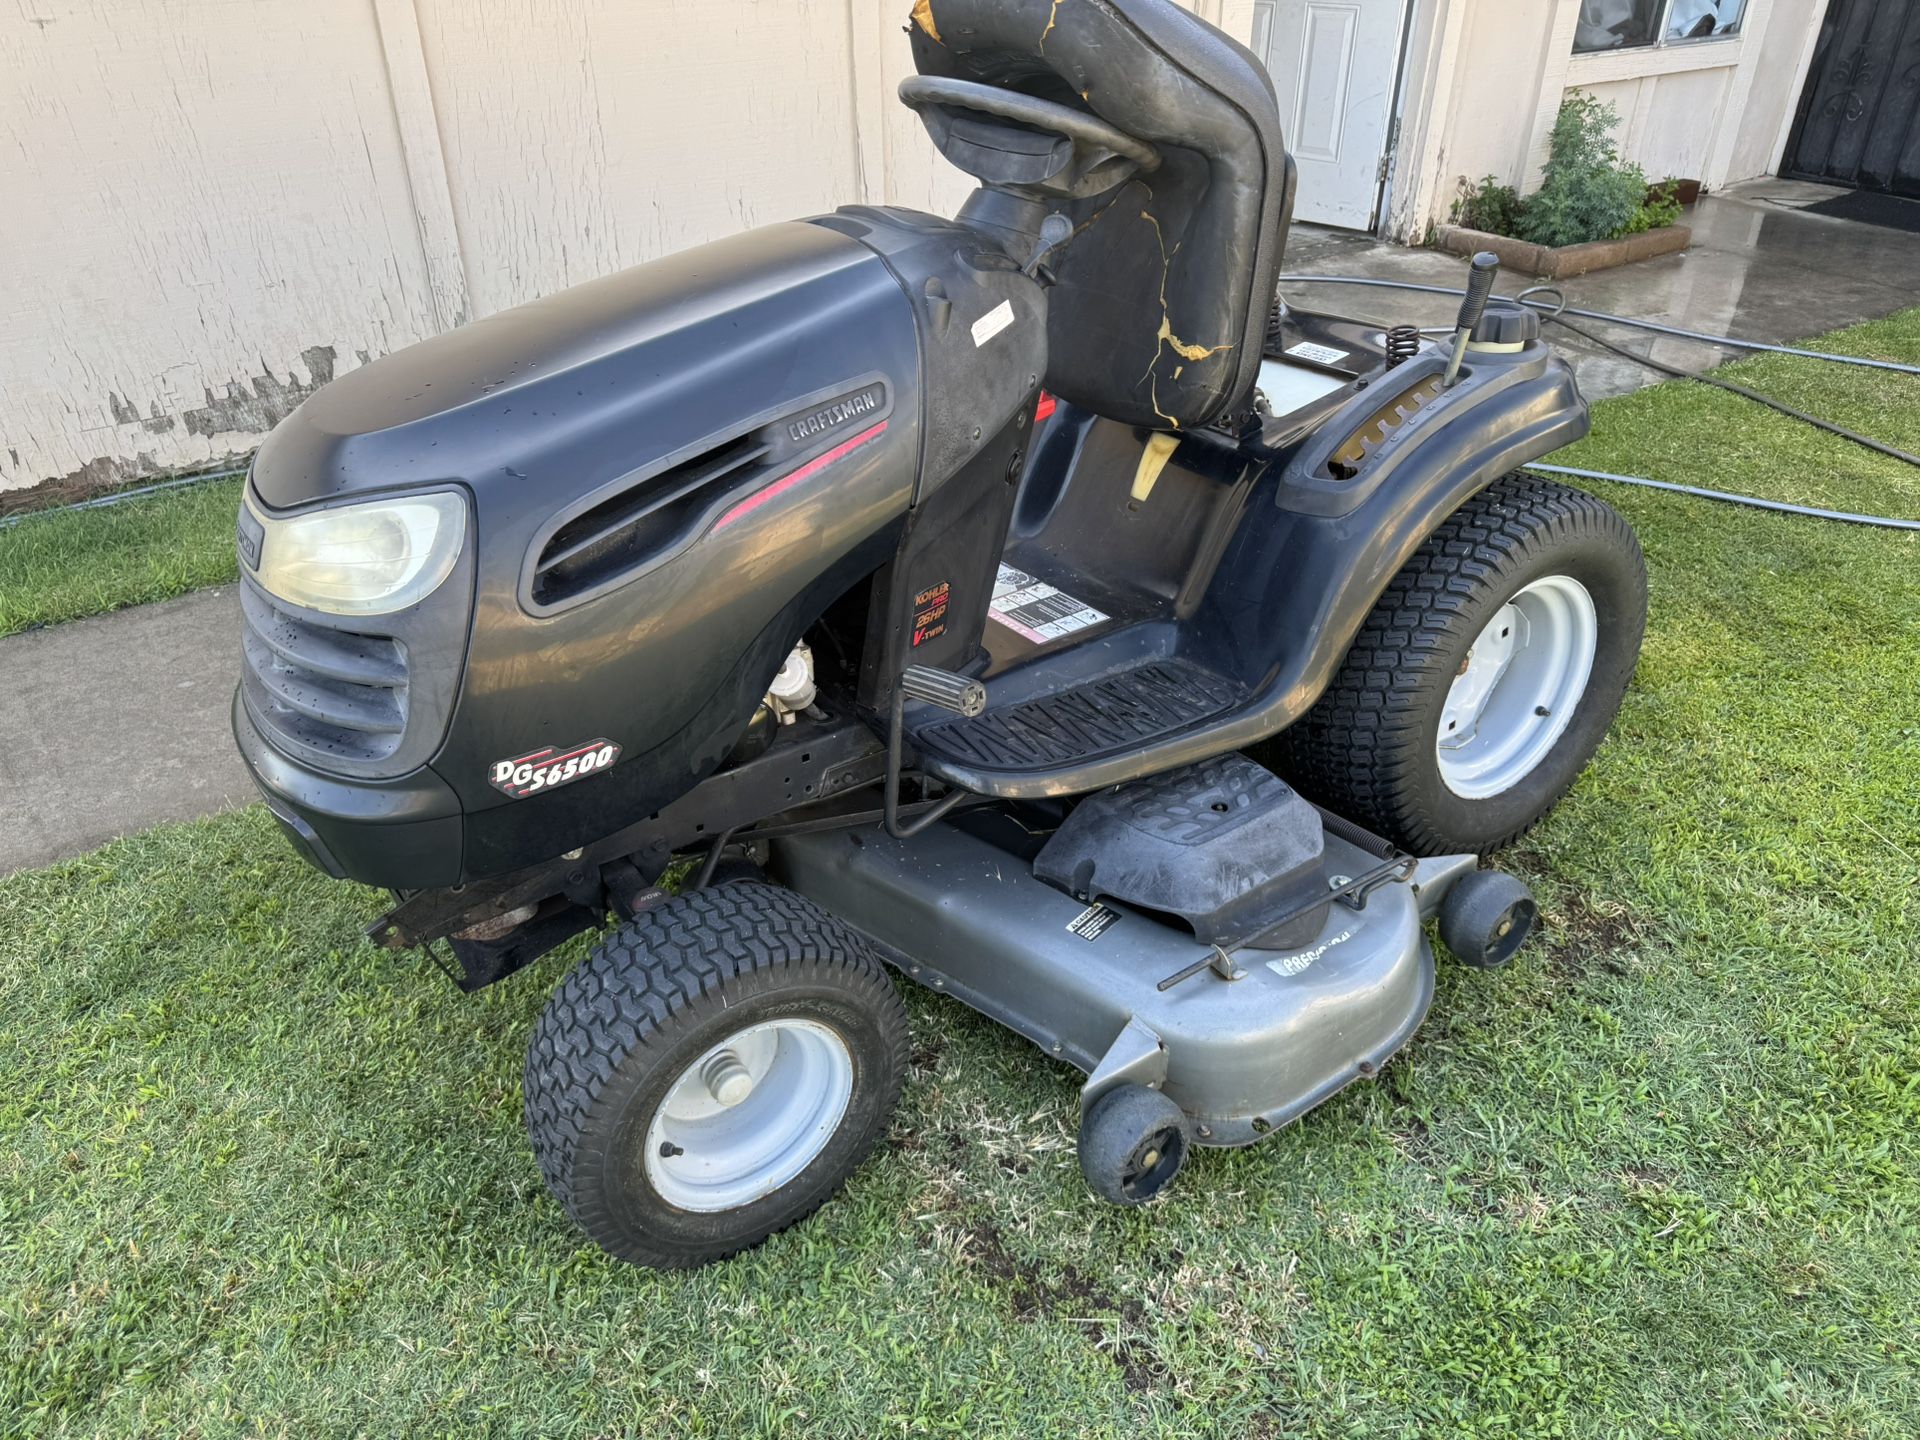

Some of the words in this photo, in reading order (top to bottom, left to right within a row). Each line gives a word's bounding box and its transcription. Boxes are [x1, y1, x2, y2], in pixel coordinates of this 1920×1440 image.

[788, 391, 876, 441] CRAFTSMAN
[915, 582, 950, 606] KOHLER
[931, 592, 949, 606] PRO
[915, 605, 946, 629] 26HP
